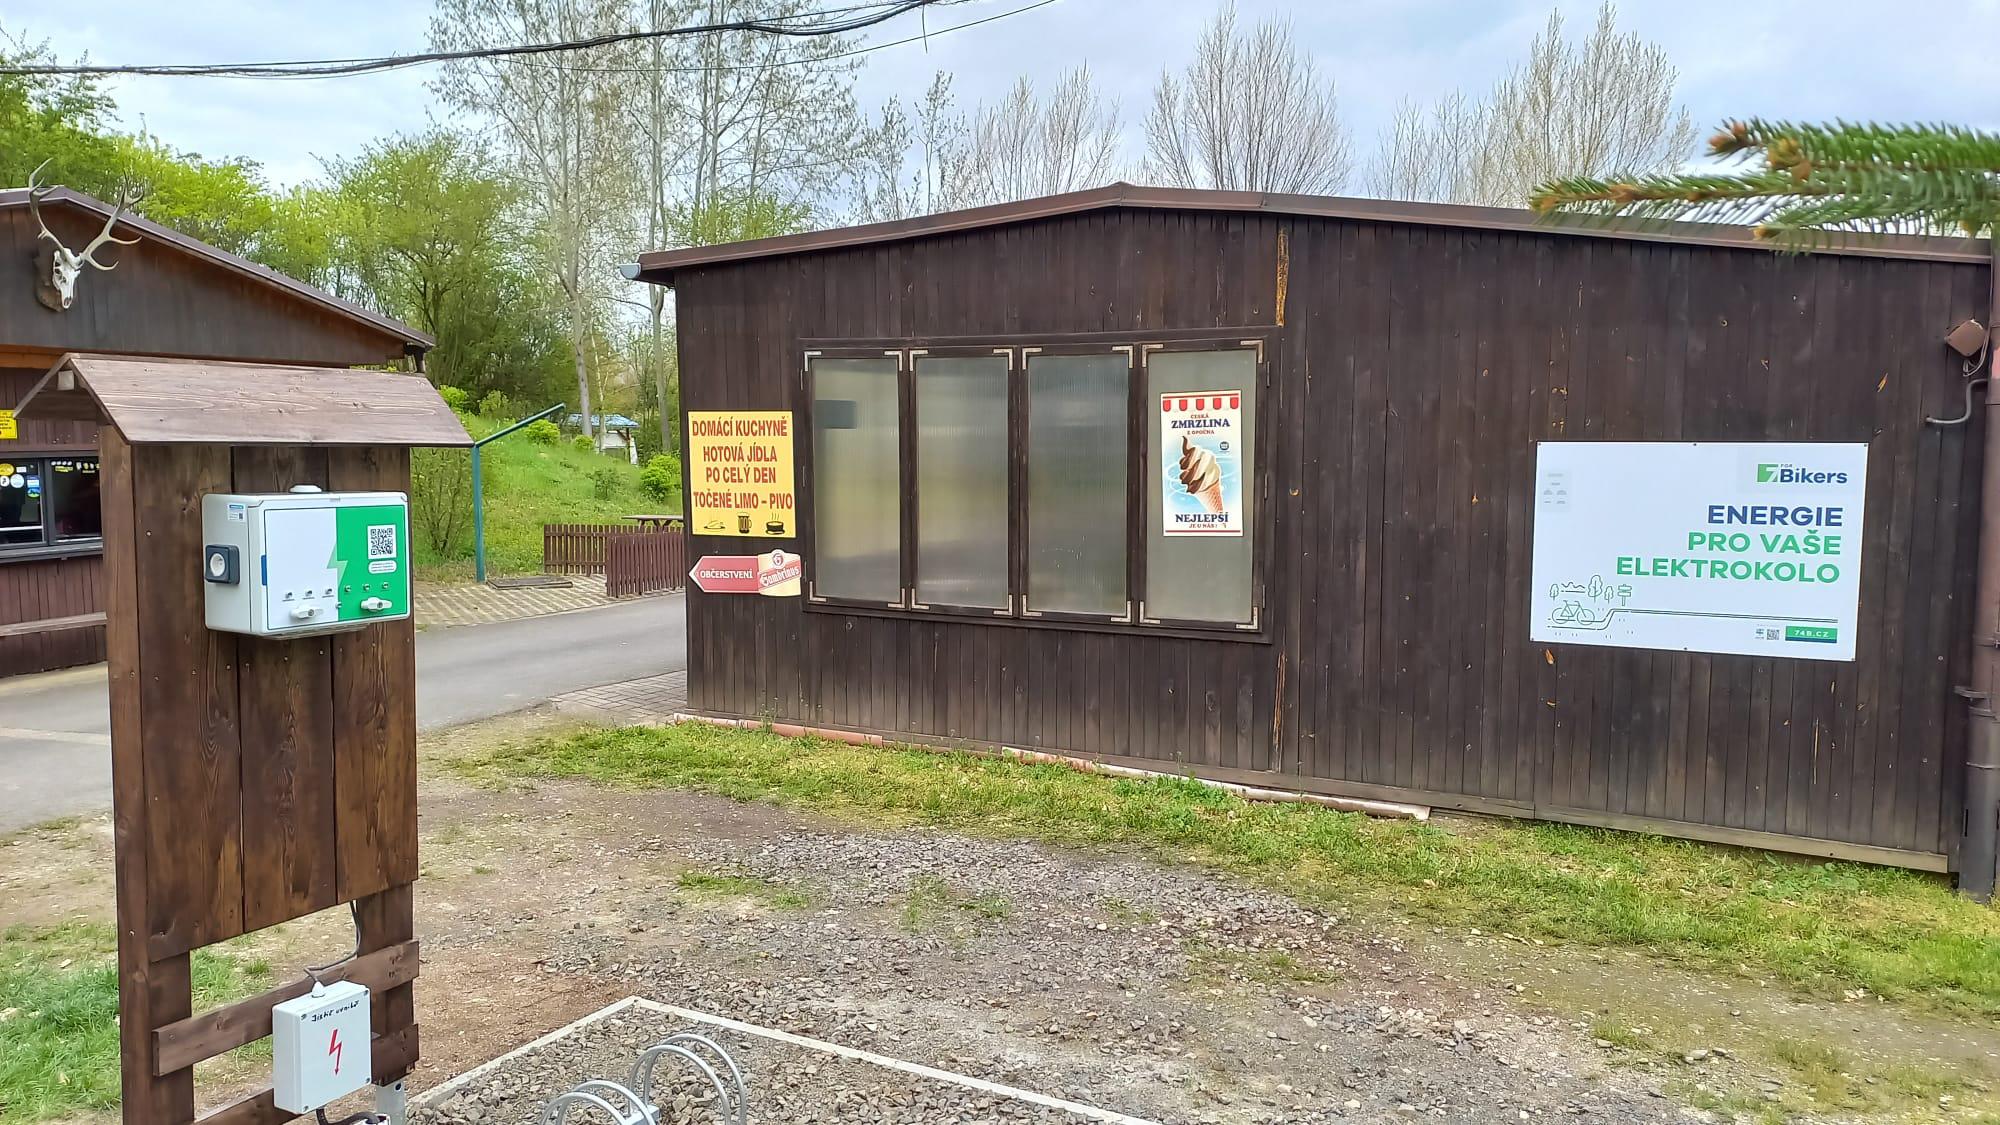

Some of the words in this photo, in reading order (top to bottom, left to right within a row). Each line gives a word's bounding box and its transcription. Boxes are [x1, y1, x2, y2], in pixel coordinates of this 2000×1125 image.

[692, 416, 733, 436] DOMÁCÍ
[736, 416, 788, 436] KUCHYNĚ
[1171, 418, 1230, 428] ZMRZLINA
[703, 442, 744, 462] HOTOVÁ
[747, 442, 778, 462] JÍDLA
[706, 467, 720, 482] PO
[723, 464, 750, 483] CELÝ
[754, 467, 776, 483] DEN
[1780, 468, 1848, 484] Bikers
[693, 489, 732, 508] TOČENÉ
[734, 492, 758, 508] LIMO
[770, 493, 793, 509] PIVO
[1175, 512, 1228, 522] NEJLEPŠÍ
[1708, 505, 1844, 526] ENERGIE
[1688, 532, 1751, 552] PRO
[1760, 529, 1842, 555] VAŠE
[700, 568, 754, 579] OBČERSTVENÍ
[1617, 556, 1840, 584] ELEKTROKOLO
